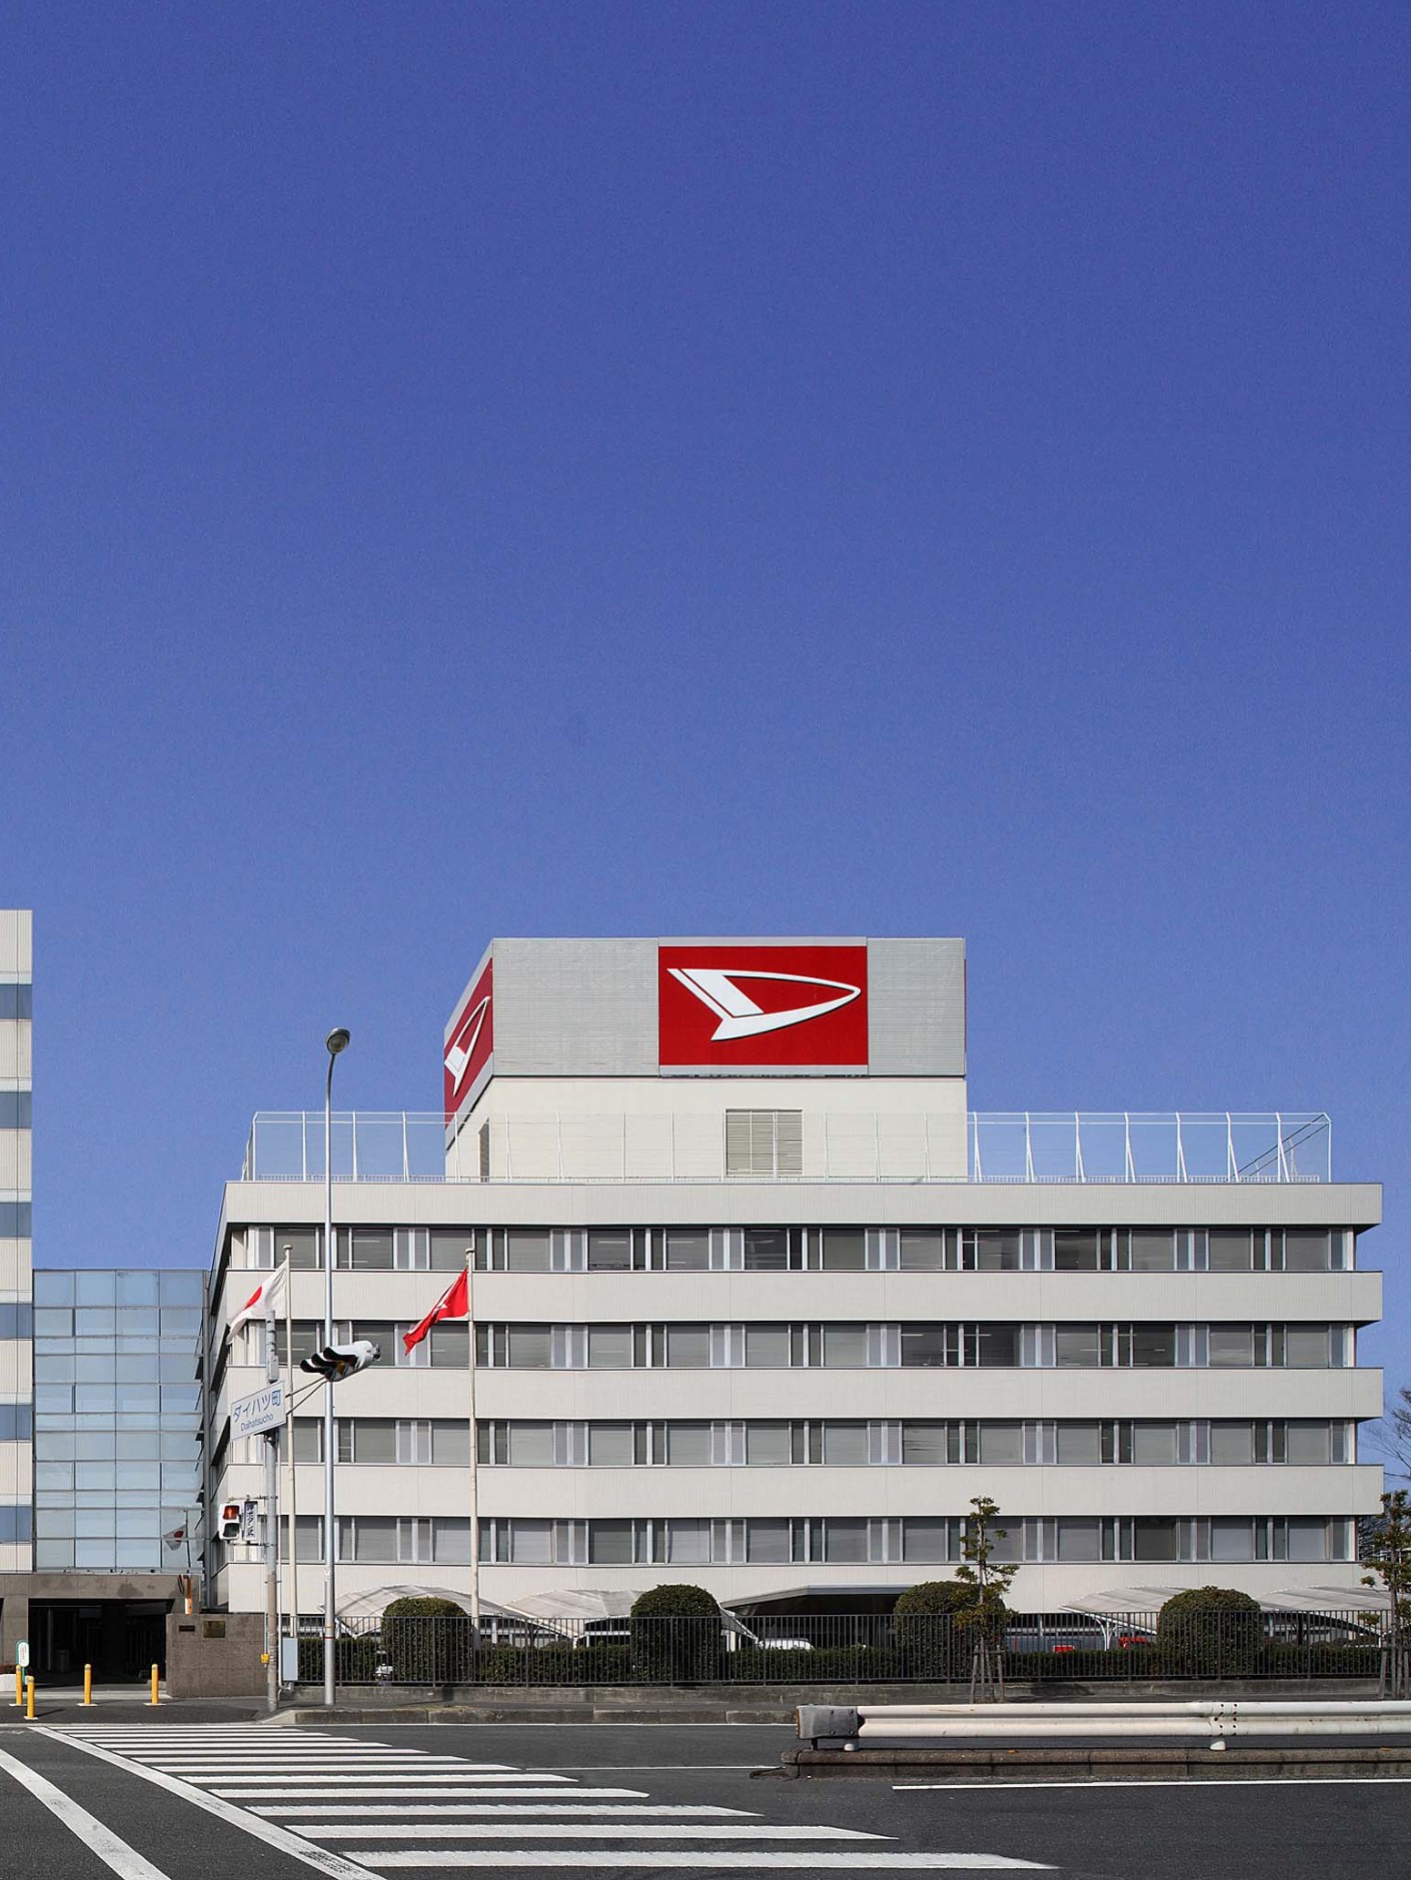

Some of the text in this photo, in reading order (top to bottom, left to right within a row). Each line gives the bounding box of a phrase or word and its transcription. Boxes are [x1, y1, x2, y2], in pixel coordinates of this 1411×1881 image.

[233, 1389, 281, 1423] ダイハツ町
